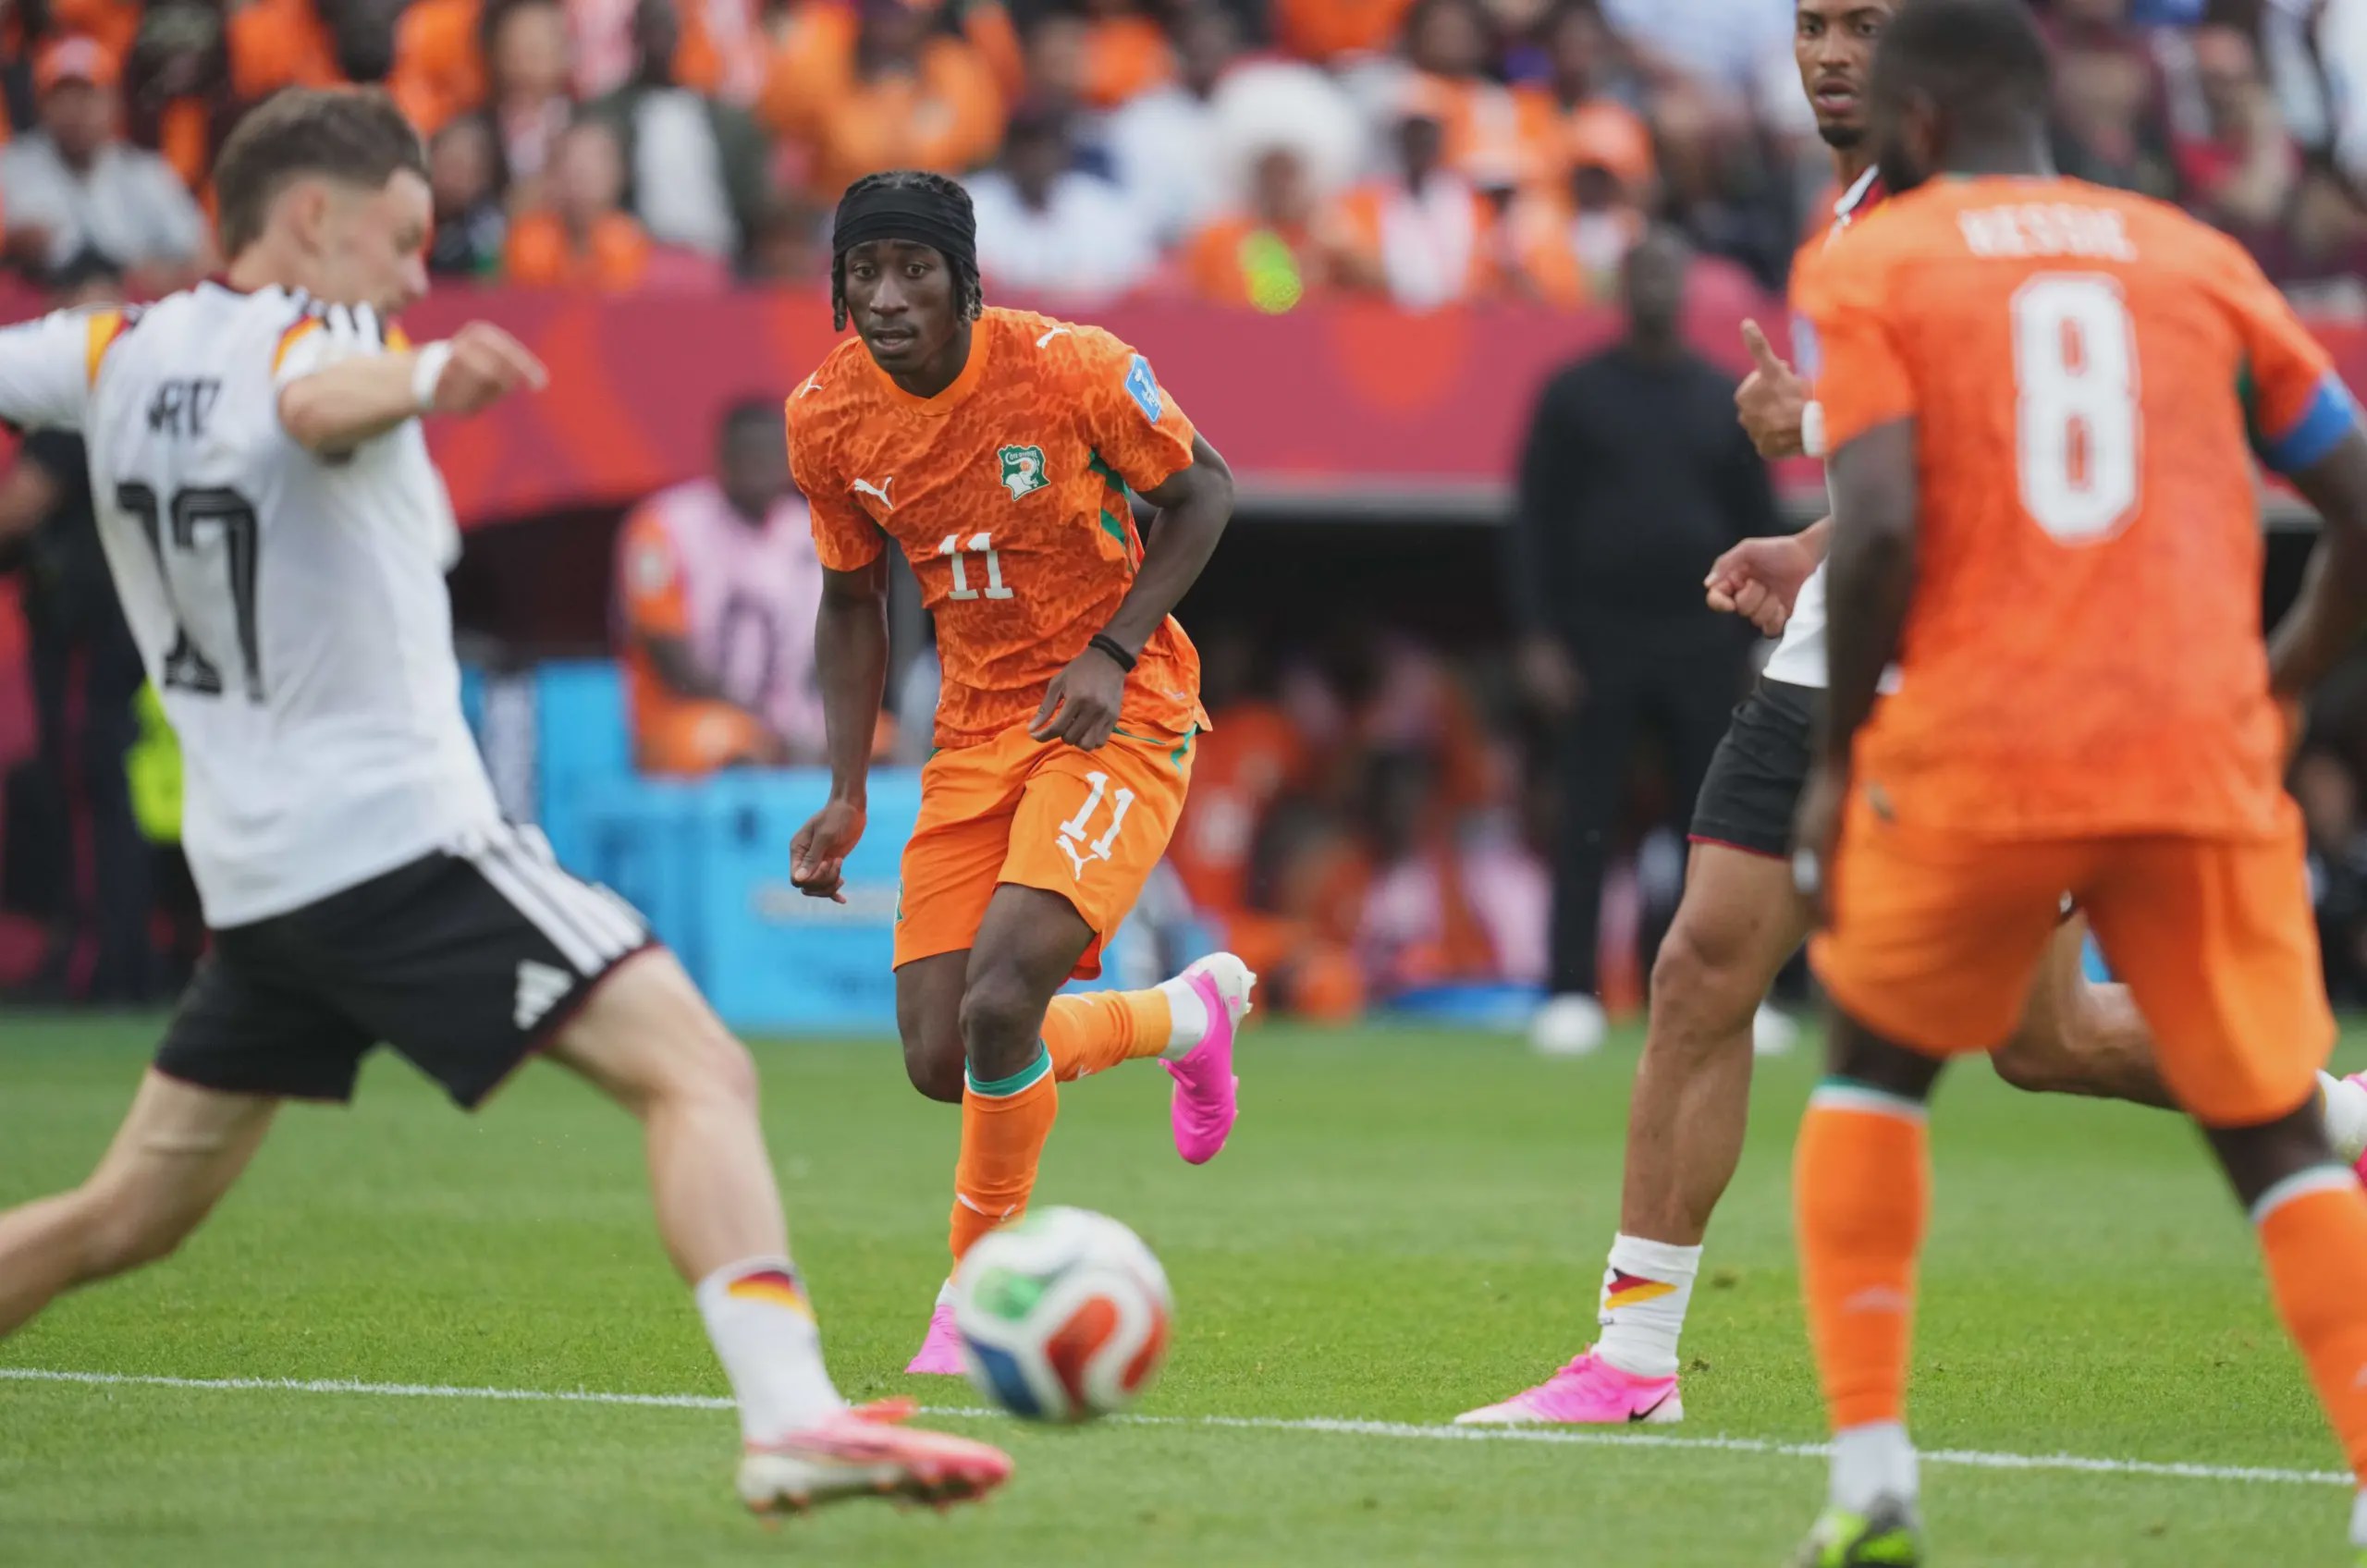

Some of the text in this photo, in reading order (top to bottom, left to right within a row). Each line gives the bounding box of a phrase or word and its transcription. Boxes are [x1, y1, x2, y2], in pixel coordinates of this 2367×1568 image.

[2009, 271, 2143, 546] 8
[116, 482, 264, 705] 17
[938, 532, 1013, 599] 11
[1060, 771, 1135, 862] 11
